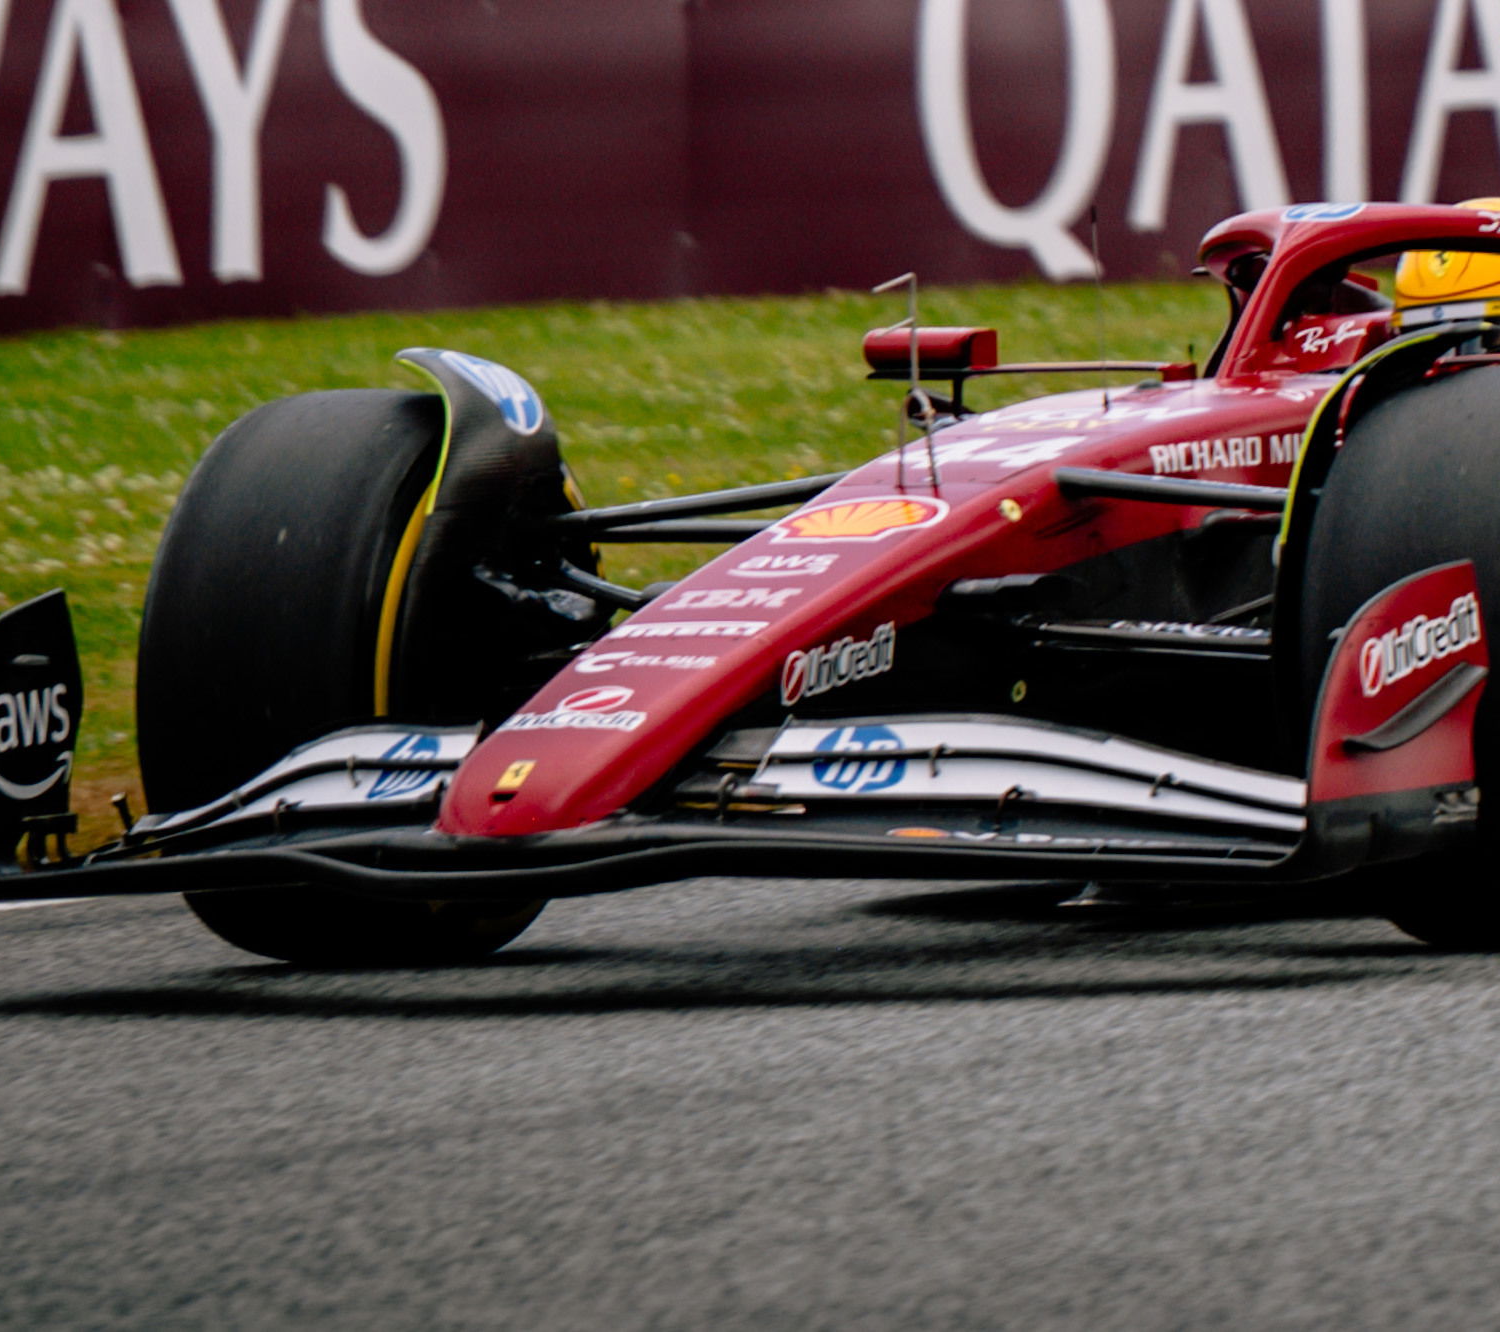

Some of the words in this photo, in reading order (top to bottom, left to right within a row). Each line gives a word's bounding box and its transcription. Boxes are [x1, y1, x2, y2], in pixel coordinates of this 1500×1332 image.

[1149, 437, 1262, 474] RICHARD
[736, 553, 841, 577] aws
[663, 587, 805, 611] IBM
[1383, 592, 1481, 687] UniCredit
[619, 655, 720, 671] CELSIUS
[803, 621, 896, 698] UniCredit
[814, 725, 905, 792] hp
